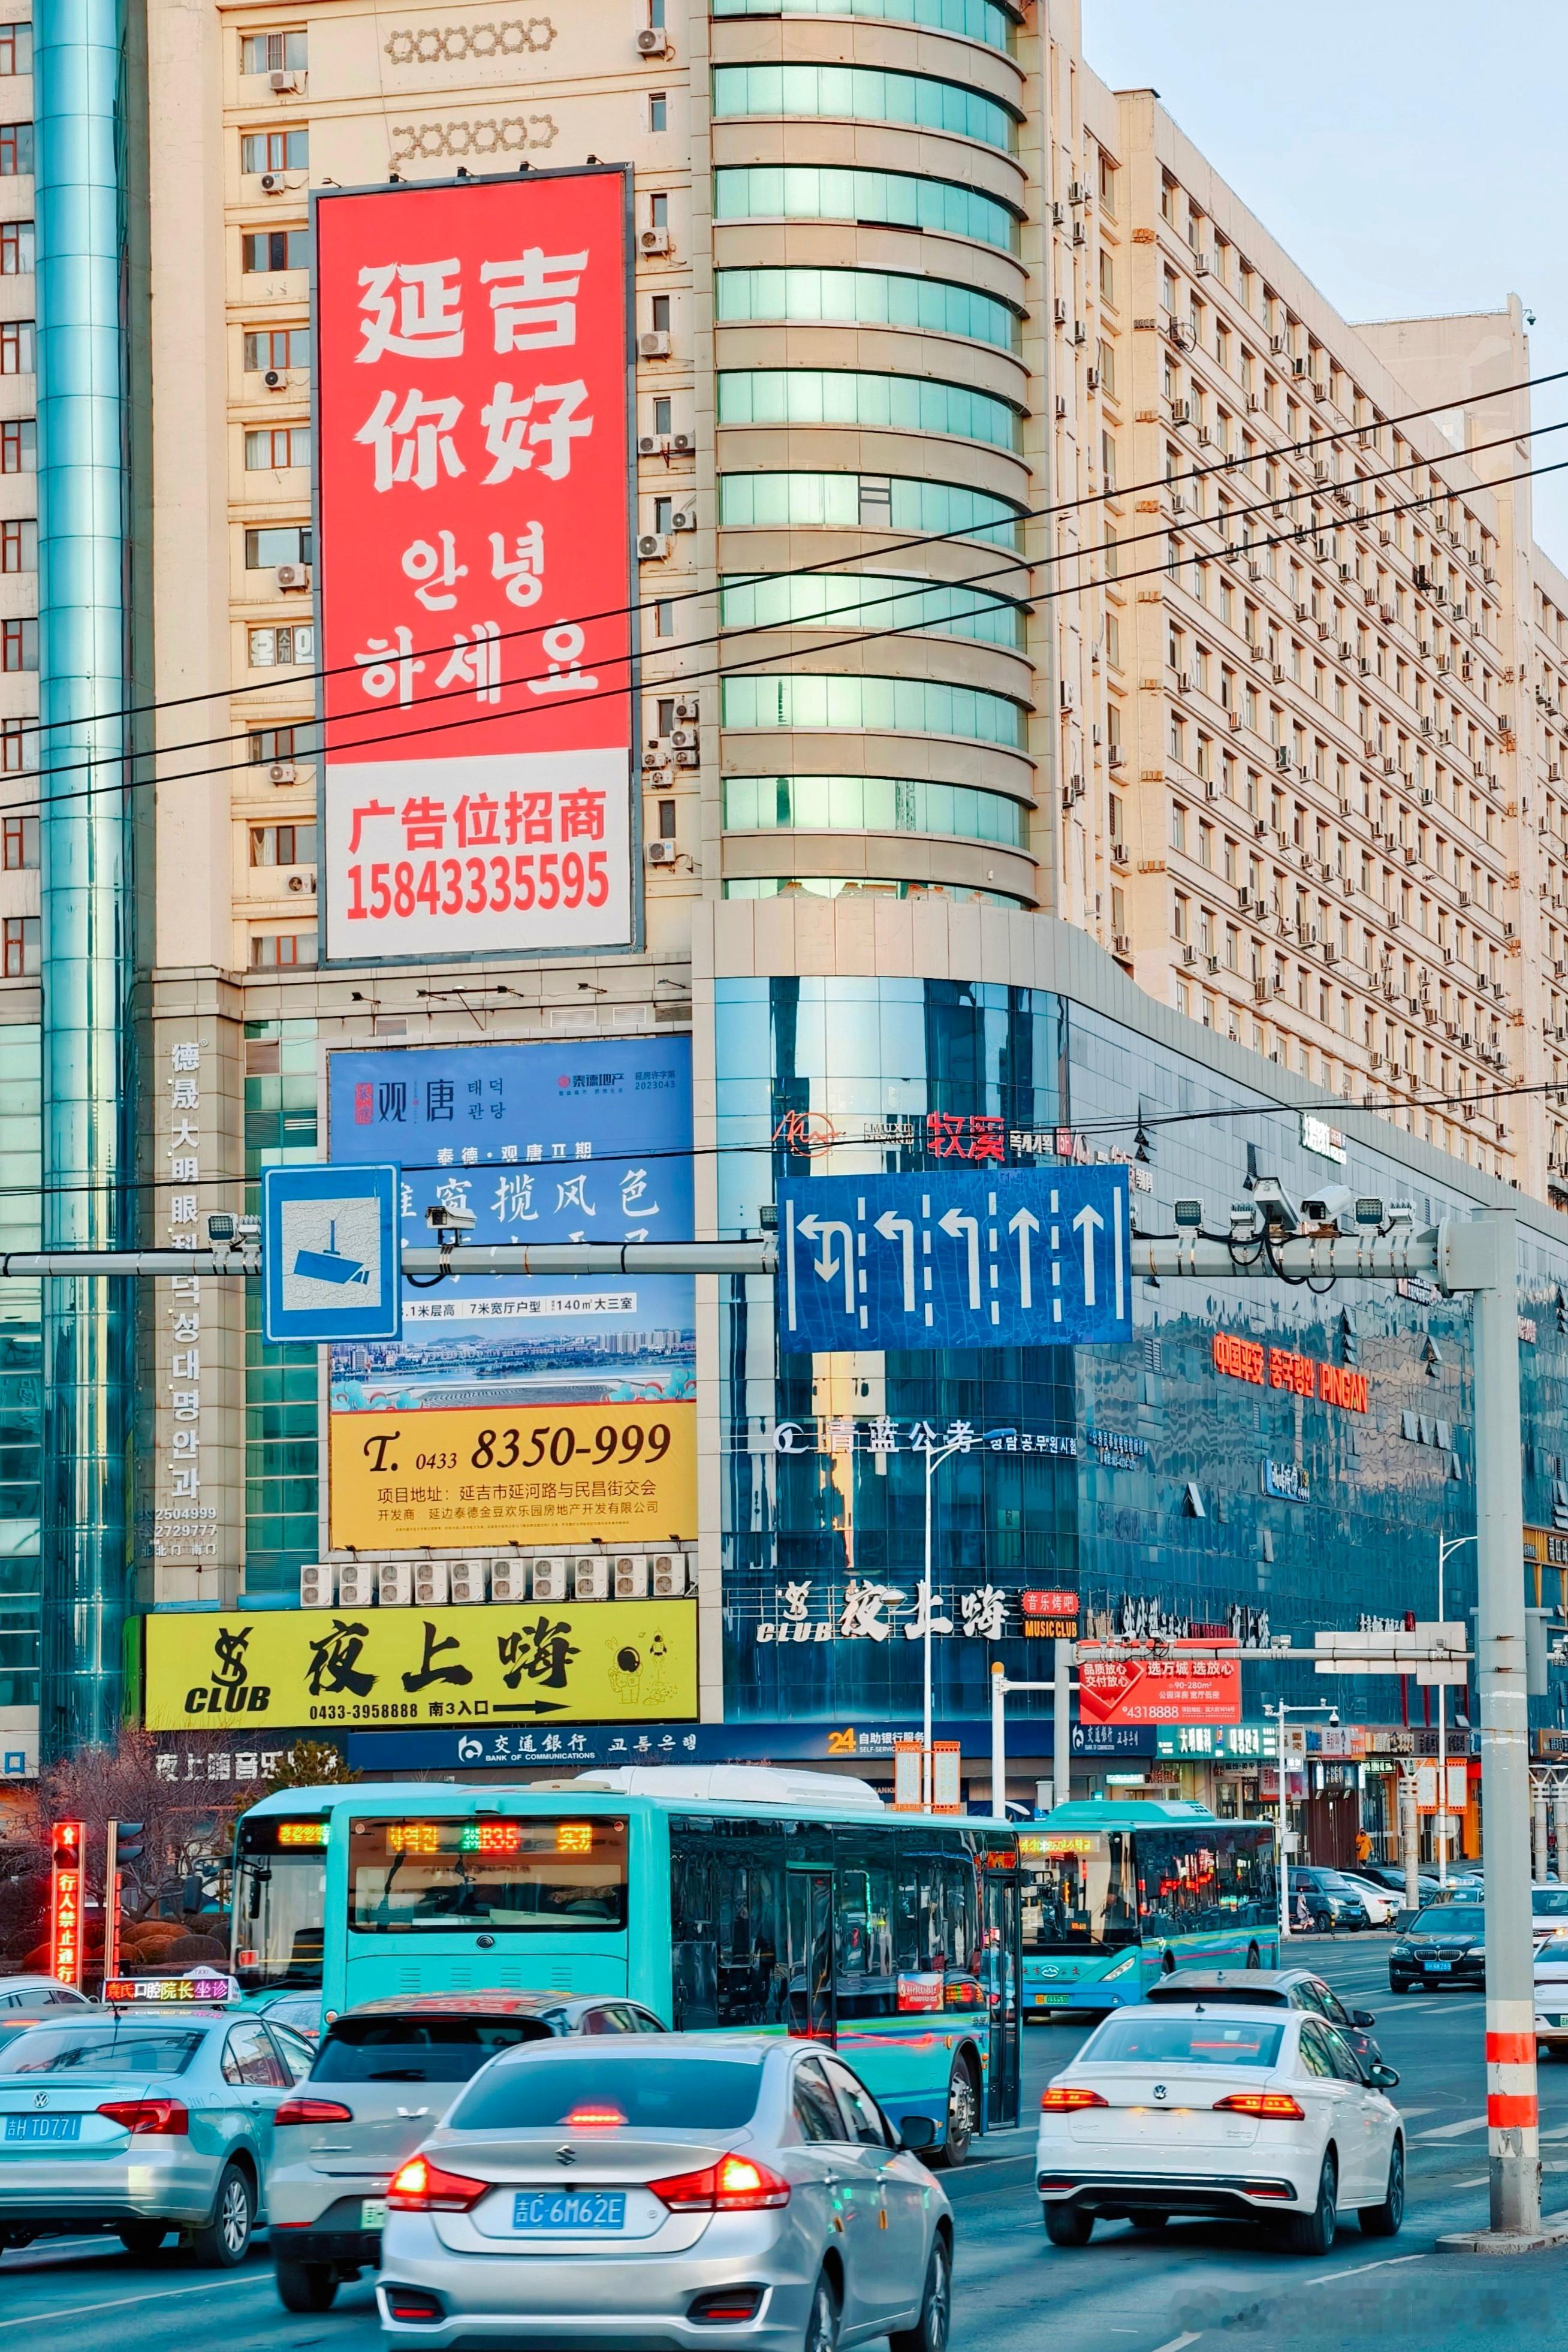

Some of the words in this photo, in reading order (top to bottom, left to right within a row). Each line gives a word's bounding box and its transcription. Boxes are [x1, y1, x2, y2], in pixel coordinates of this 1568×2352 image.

[354, 246, 589, 364] 延吉
[353, 379, 593, 493] 你好
[402, 520, 544, 611] 안녕
[354, 619, 598, 710] 하세요
[348, 786, 607, 854] 广告位招商
[347, 851, 609, 919] 15843335595
[572, 1073, 624, 1087] 泰德地产
[635, 1080, 676, 1090] 2023043
[1213, 1331, 1264, 1385] 中国平安
[827, 1415, 975, 1454] 青蓝公考
[416, 1452, 457, 1471] 0433
[471, 1424, 671, 1469] 8350-999
[155, 1507, 216, 1521] 2504999
[155, 1524, 216, 1537] 2729777
[756, 1622, 834, 1643] CLUB
[1025, 1620, 1055, 1638] MUSIC
[1056, 1620, 1077, 1638] CLUB
[304, 1616, 583, 1698] 夜上嗨
[1084, 1663, 1127, 1676] 品质放心
[1148, 1662, 1189, 1676] 选万城
[1192, 1662, 1235, 1676] 选放心
[1085, 1676, 1129, 1688] 交付放心
[185, 1686, 270, 1714] CLUB
[428, 1700, 490, 1718] 南3入口
[309, 1702, 418, 1721] 0433-3958888
[1126, 1706, 1179, 1719] 4318888
[608, 1733, 697, 1753] 교통은행
[828, 1727, 857, 1753] 24
[525, 1752, 595, 1760] COMMUNICATIONS
[58, 1874, 76, 1983] 行人禁止通行
[107, 1980, 228, 2000] 袁氏口腔院长坐诊
